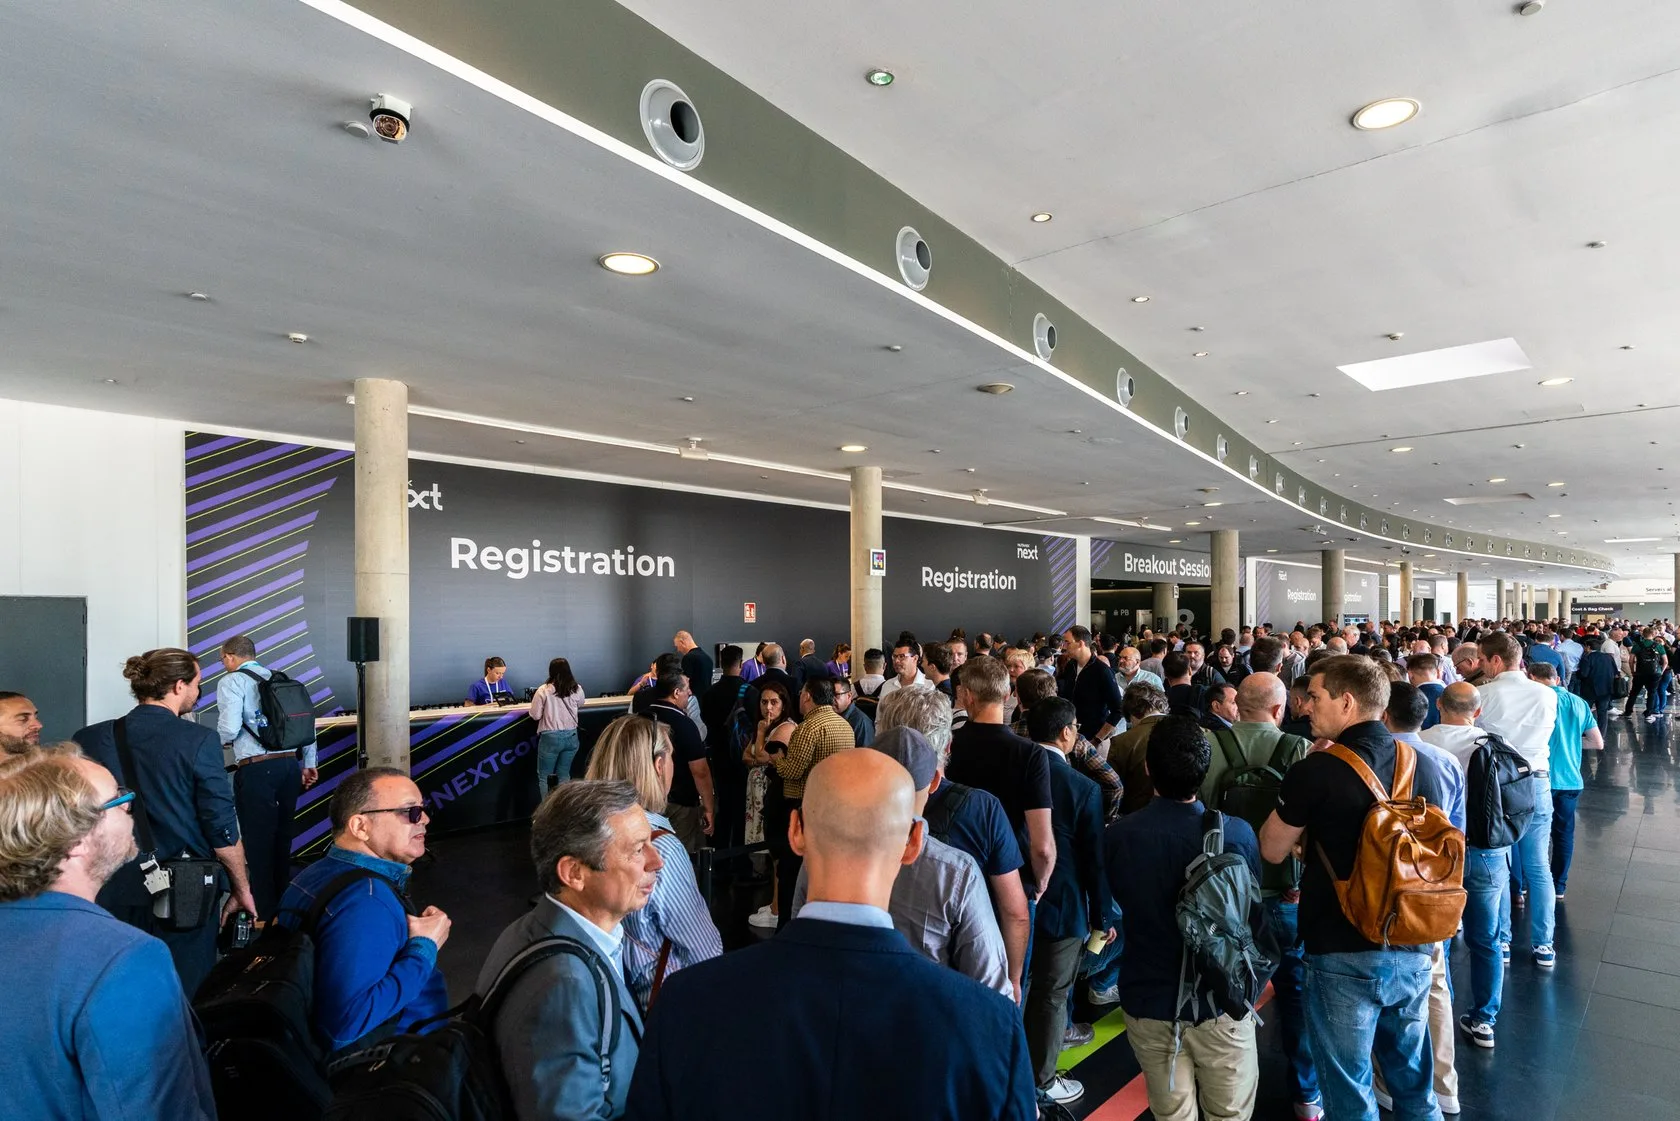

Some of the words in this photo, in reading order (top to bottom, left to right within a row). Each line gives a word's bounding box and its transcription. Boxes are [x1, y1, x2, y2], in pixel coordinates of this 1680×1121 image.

[408, 483, 443, 511] xt
[451, 537, 675, 579] Registration
[1017, 545, 1038, 560] next
[1124, 552, 1177, 575] Breakout
[1179, 558, 1211, 578] Sessio
[922, 566, 1017, 593] Registration
[1287, 588, 1317, 603] Registration
[1120, 608, 1130, 616] PB
